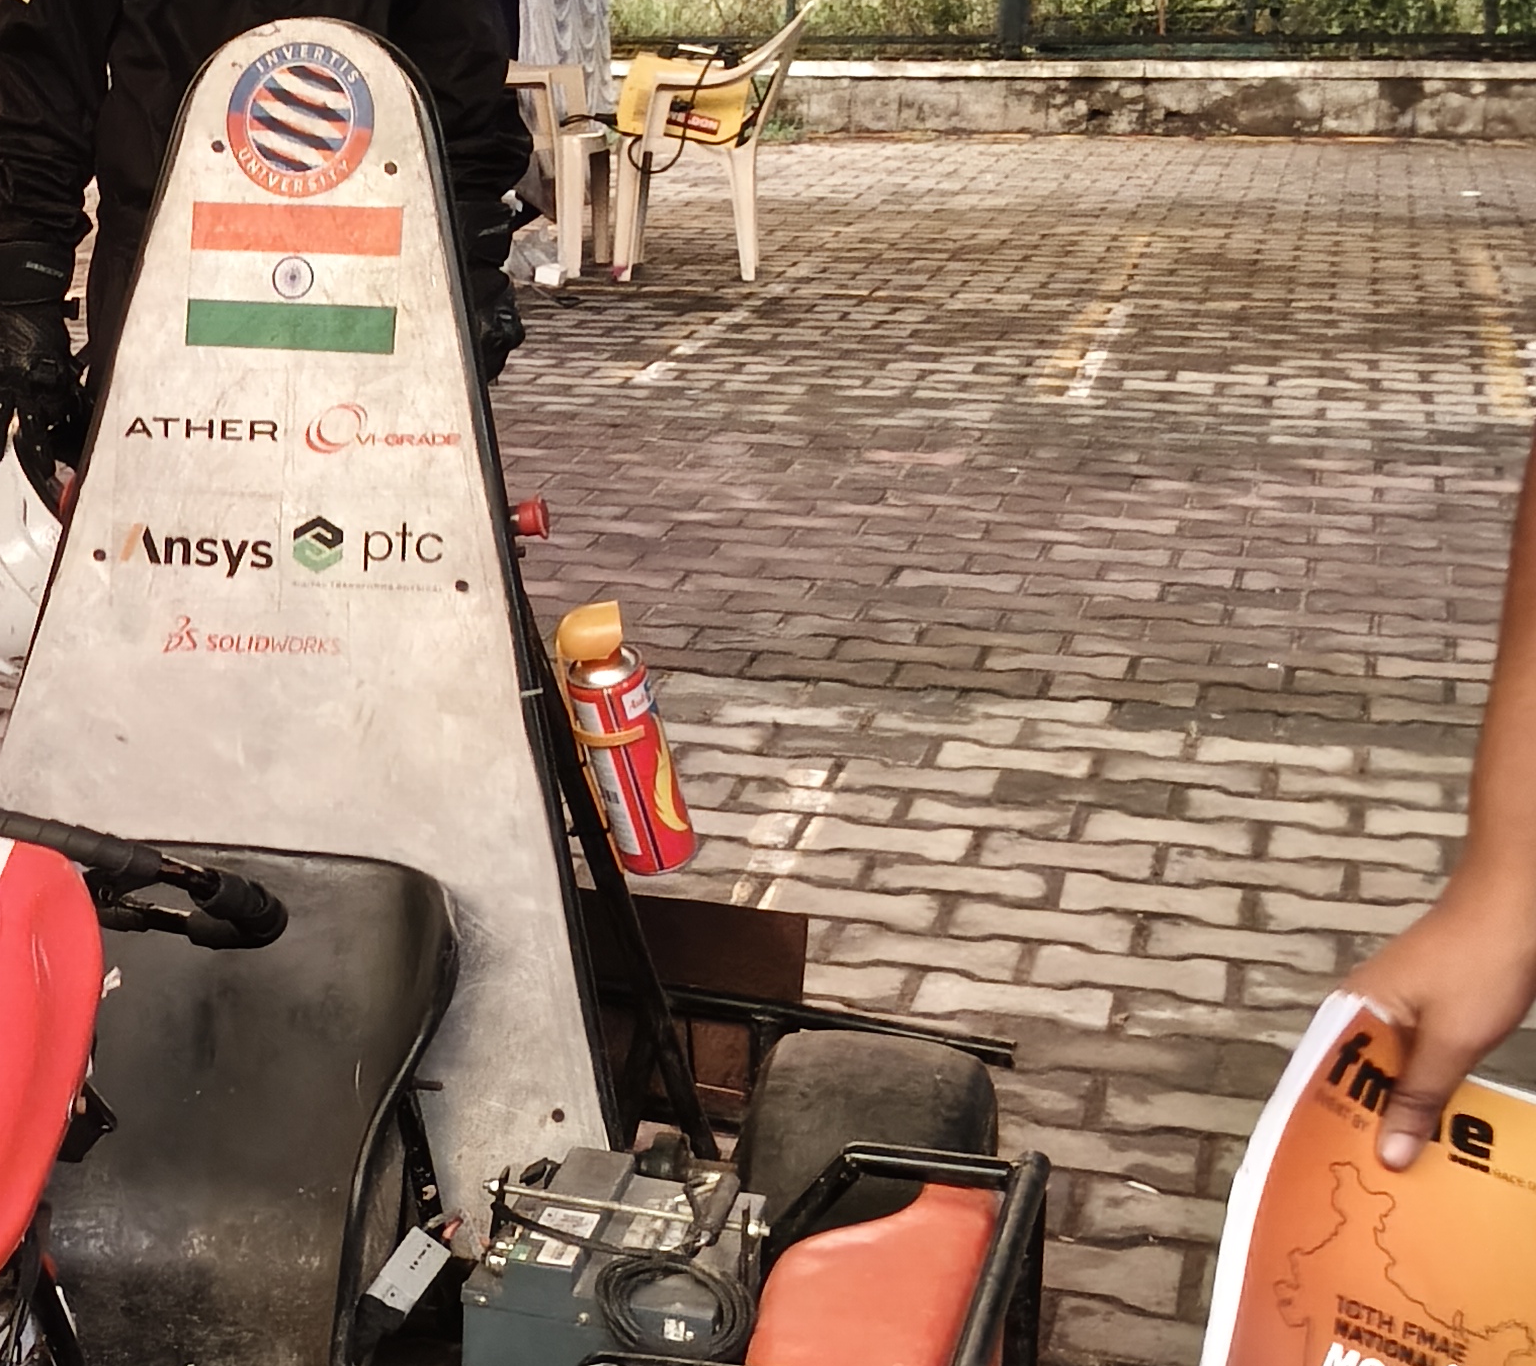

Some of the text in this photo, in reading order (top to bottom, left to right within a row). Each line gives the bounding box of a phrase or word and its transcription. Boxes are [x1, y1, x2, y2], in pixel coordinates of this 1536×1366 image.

[255, 43, 360, 84] INVERTIS
[238, 147, 349, 193] UNIVERSITY
[125, 416, 278, 443] ATHER
[355, 431, 461, 448] VI-GRADE
[119, 522, 274, 579] Ansys
[363, 521, 444, 573] ptc
[204, 633, 342, 655] SOLIDWORKS
